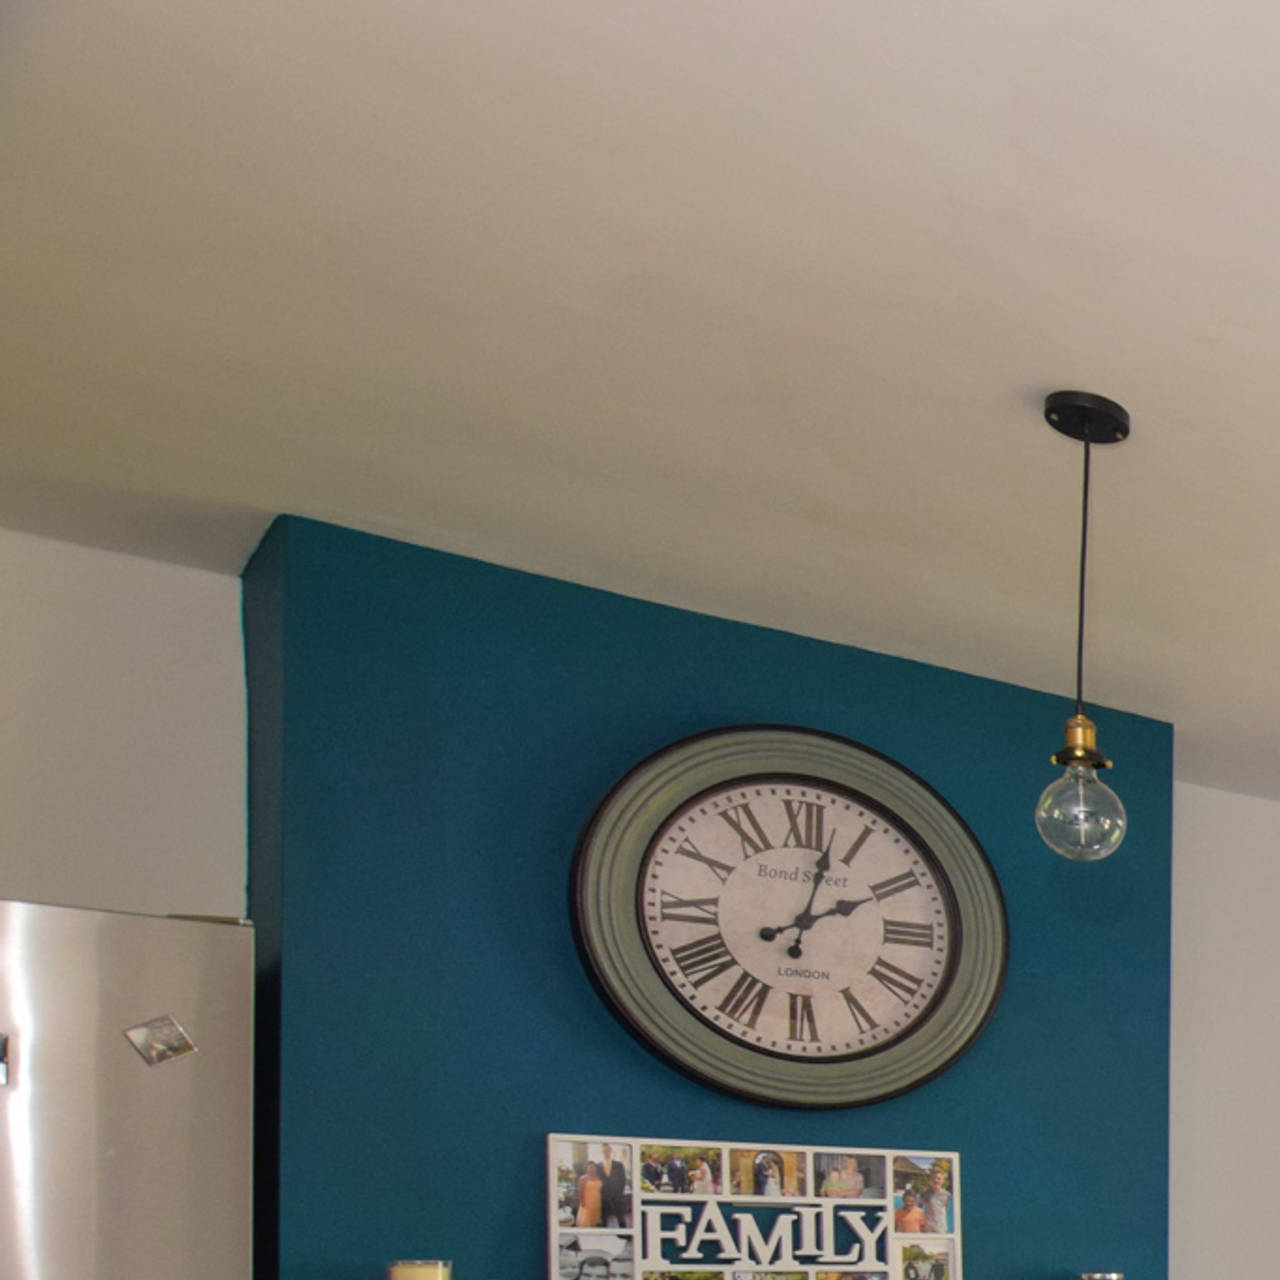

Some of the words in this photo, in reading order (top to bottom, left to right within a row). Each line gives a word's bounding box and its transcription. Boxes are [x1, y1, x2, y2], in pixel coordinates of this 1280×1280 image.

[718, 803, 774, 861] XI
[782, 799, 826, 853] XII
[838, 824, 875, 868] I
[675, 836, 736, 885] X
[757, 863, 800, 882] Bond
[802, 869, 848, 889] Seet
[868, 868, 921, 902] II
[660, 890, 719, 926] IX
[882, 917, 934, 950] III
[669, 930, 741, 991] VIII
[777, 967, 831, 981] LONDON
[867, 955, 925, 1007] IV
[715, 968, 774, 1031] VII
[787, 992, 821, 1043] VI
[840, 986, 881, 1035] V
[641, 1199, 889, 1267] FAMILY
